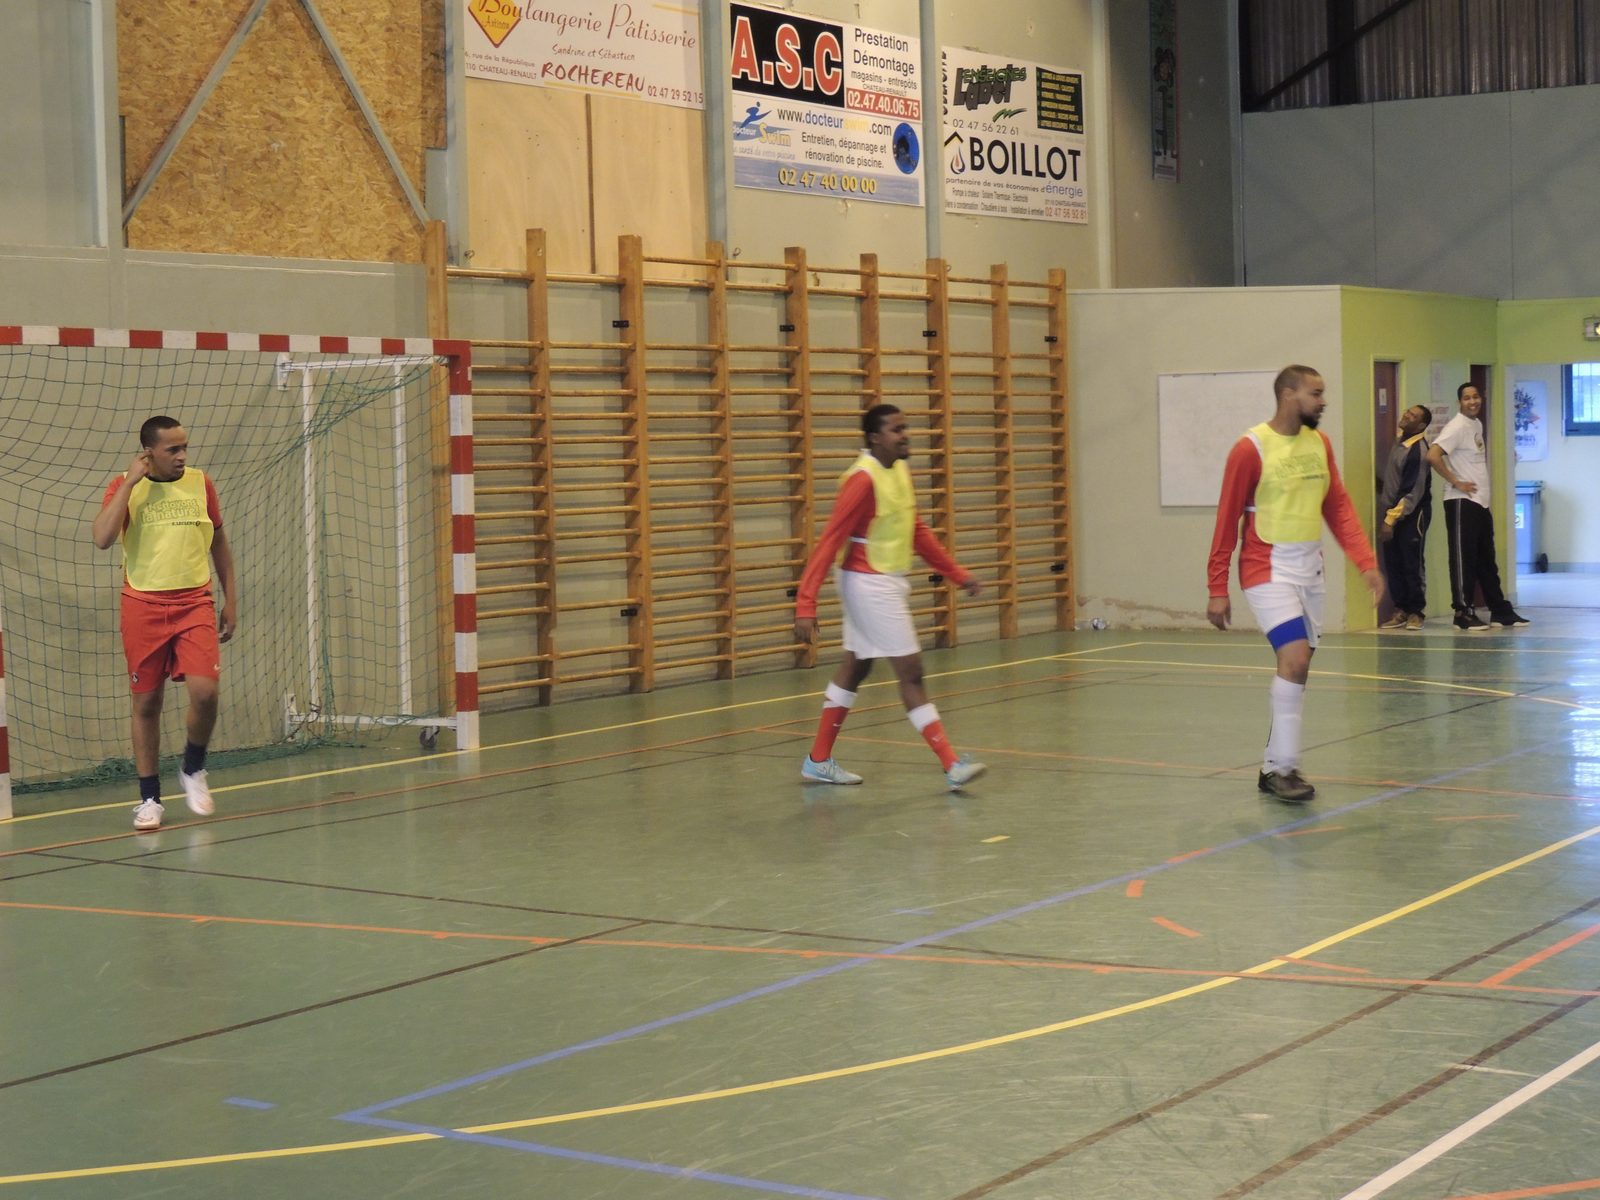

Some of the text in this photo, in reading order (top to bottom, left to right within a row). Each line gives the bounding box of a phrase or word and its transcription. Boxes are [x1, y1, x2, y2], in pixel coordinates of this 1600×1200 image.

[607, 3, 696, 48] Pâtisserie
[552, 43, 636, 61] Sandrine et Sébastien
[854, 28, 909, 53] Prestation
[731, 15, 842, 96] A.S.C
[853, 49, 915, 77] Démontage
[541, 62, 704, 104] ROCHEREAU 02 47 29 52 15
[851, 70, 882, 83] magasins
[847, 90, 919, 118] 02.47.40.06.75
[759, 122, 792, 147] Swim
[952, 118, 1019, 136] 02 47 56 22 61
[801, 131, 887, 154] Entretien, dépannage et
[805, 148, 884, 169] rénovation de piscine.
[969, 136, 1081, 182] BOILLOT
[778, 167, 877, 194] 02 47 40 00 00
[945, 177, 982, 186] partenaire
[983, 179, 991, 187] de
[1005, 182, 1039, 193] économies
[1044, 206, 1053, 217] 02
[1054, 207, 1062, 218] 47
